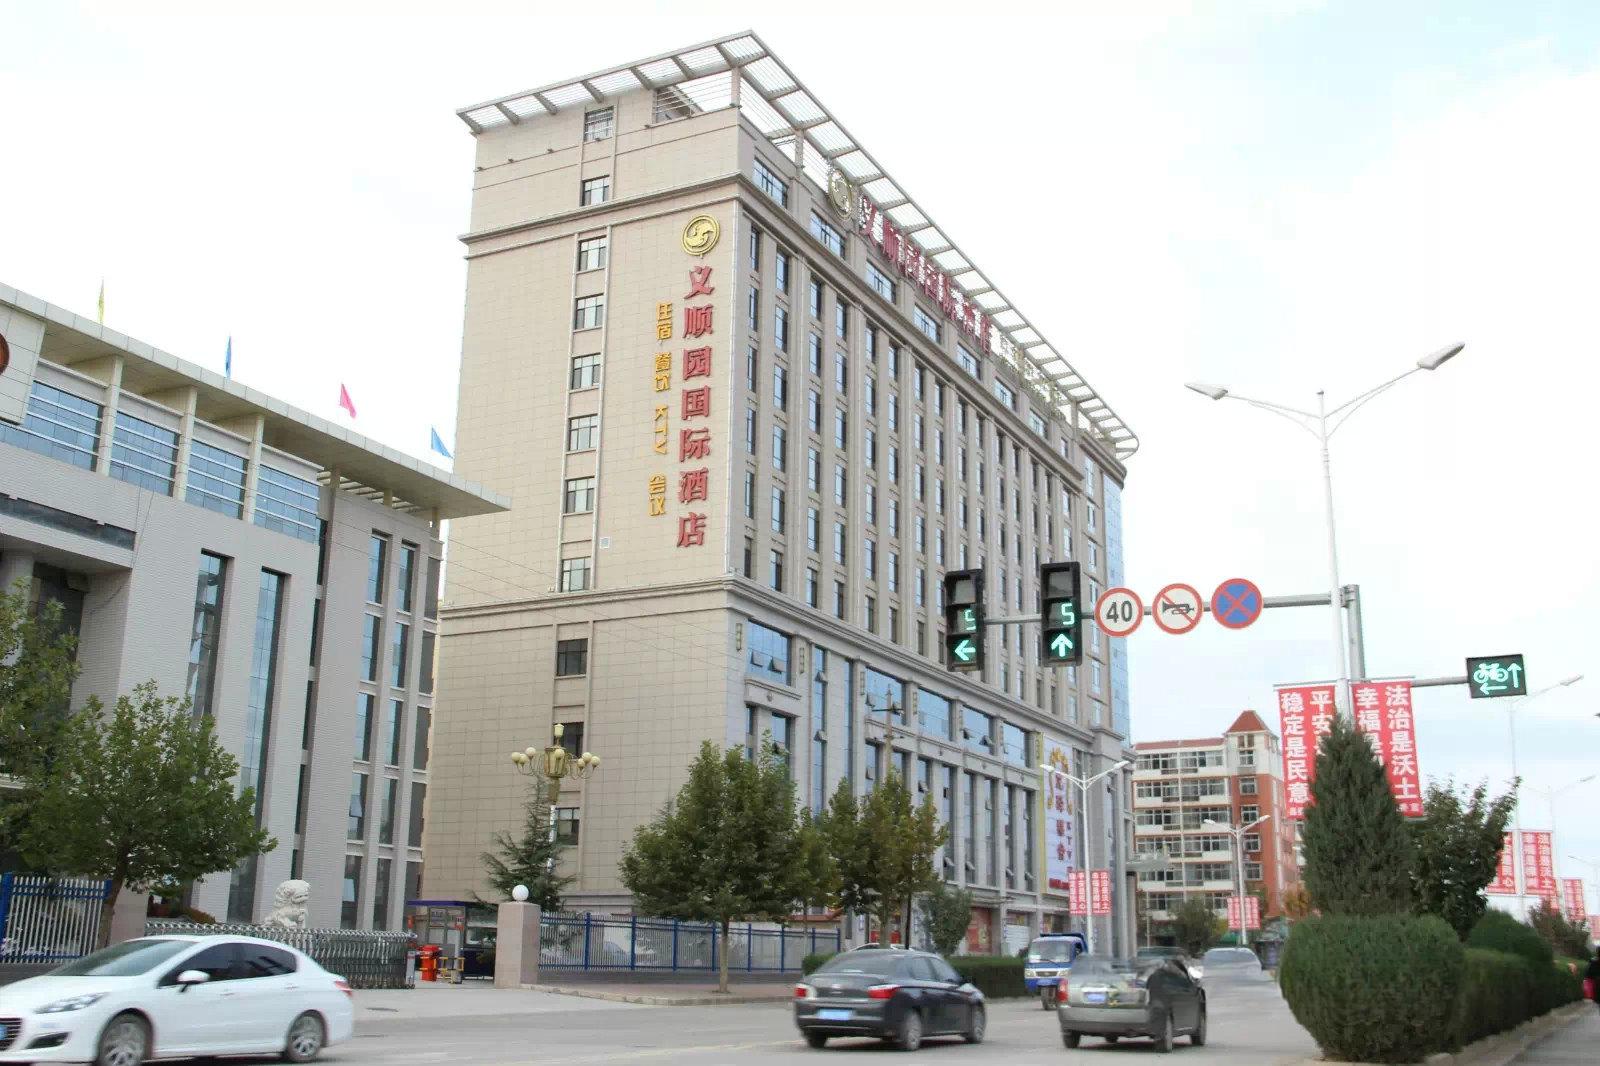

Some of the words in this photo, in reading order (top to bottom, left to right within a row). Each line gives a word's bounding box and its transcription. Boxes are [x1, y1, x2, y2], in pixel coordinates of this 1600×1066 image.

[656, 301, 673, 340] 住宿
[655, 352, 671, 392] 餐饮
[654, 404, 669, 455] KTV
[677, 265, 715, 548] 义顺园国际酒店
[649, 472, 667, 517] 会议
[1061, 603, 1075, 625] 5
[1106, 600, 1133, 623] 40
[1281, 692, 1310, 803] 稳定是民意
[1355, 687, 1384, 766] 幸福是
[1385, 685, 1417, 799] 法治是沃土
